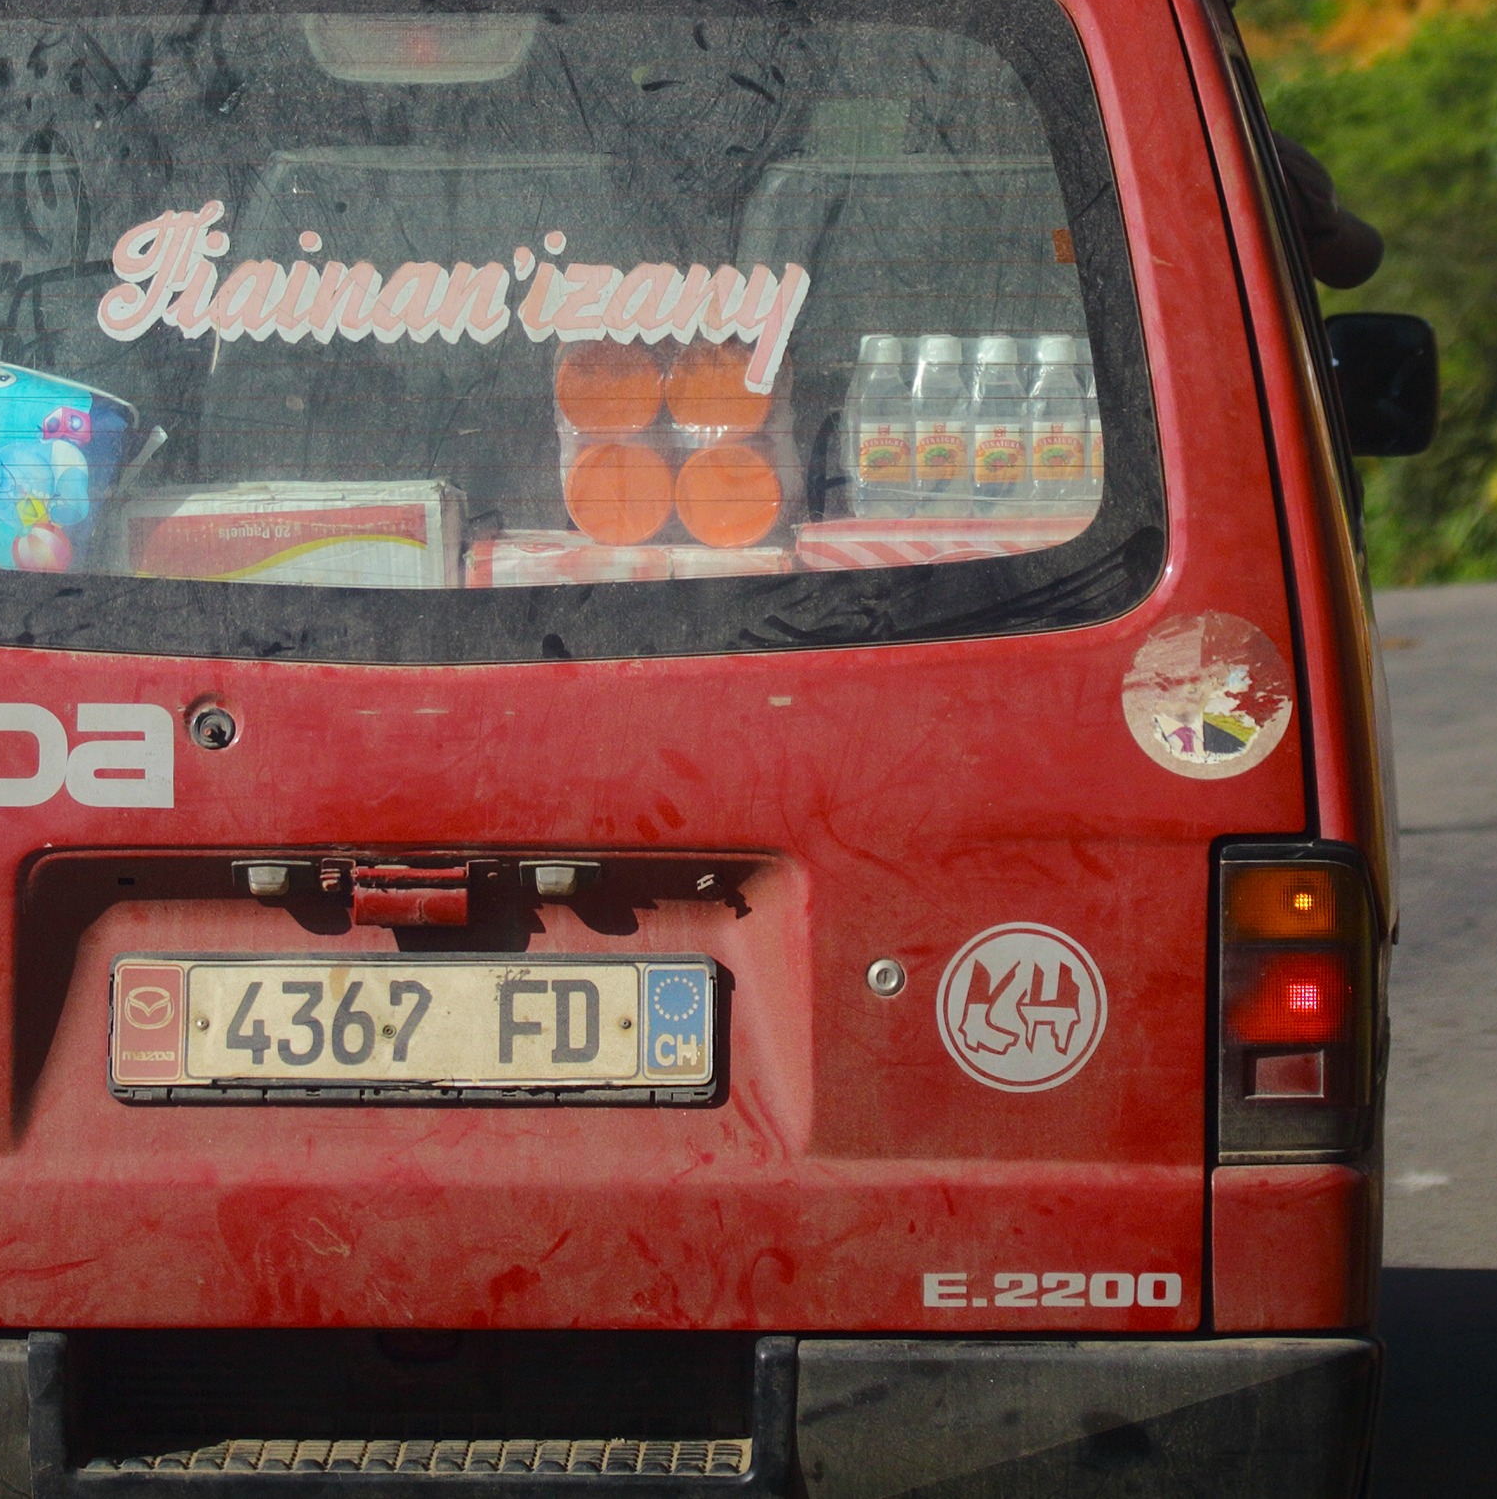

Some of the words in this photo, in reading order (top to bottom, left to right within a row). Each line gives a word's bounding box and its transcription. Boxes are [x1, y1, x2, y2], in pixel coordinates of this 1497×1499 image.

[218, 522, 271, 540] Paquets
[225, 980, 433, 1066] 4367
[498, 979, 600, 1065] FD
[655, 1034, 700, 1068] CH
[923, 1272, 1182, 1308] E.2200
